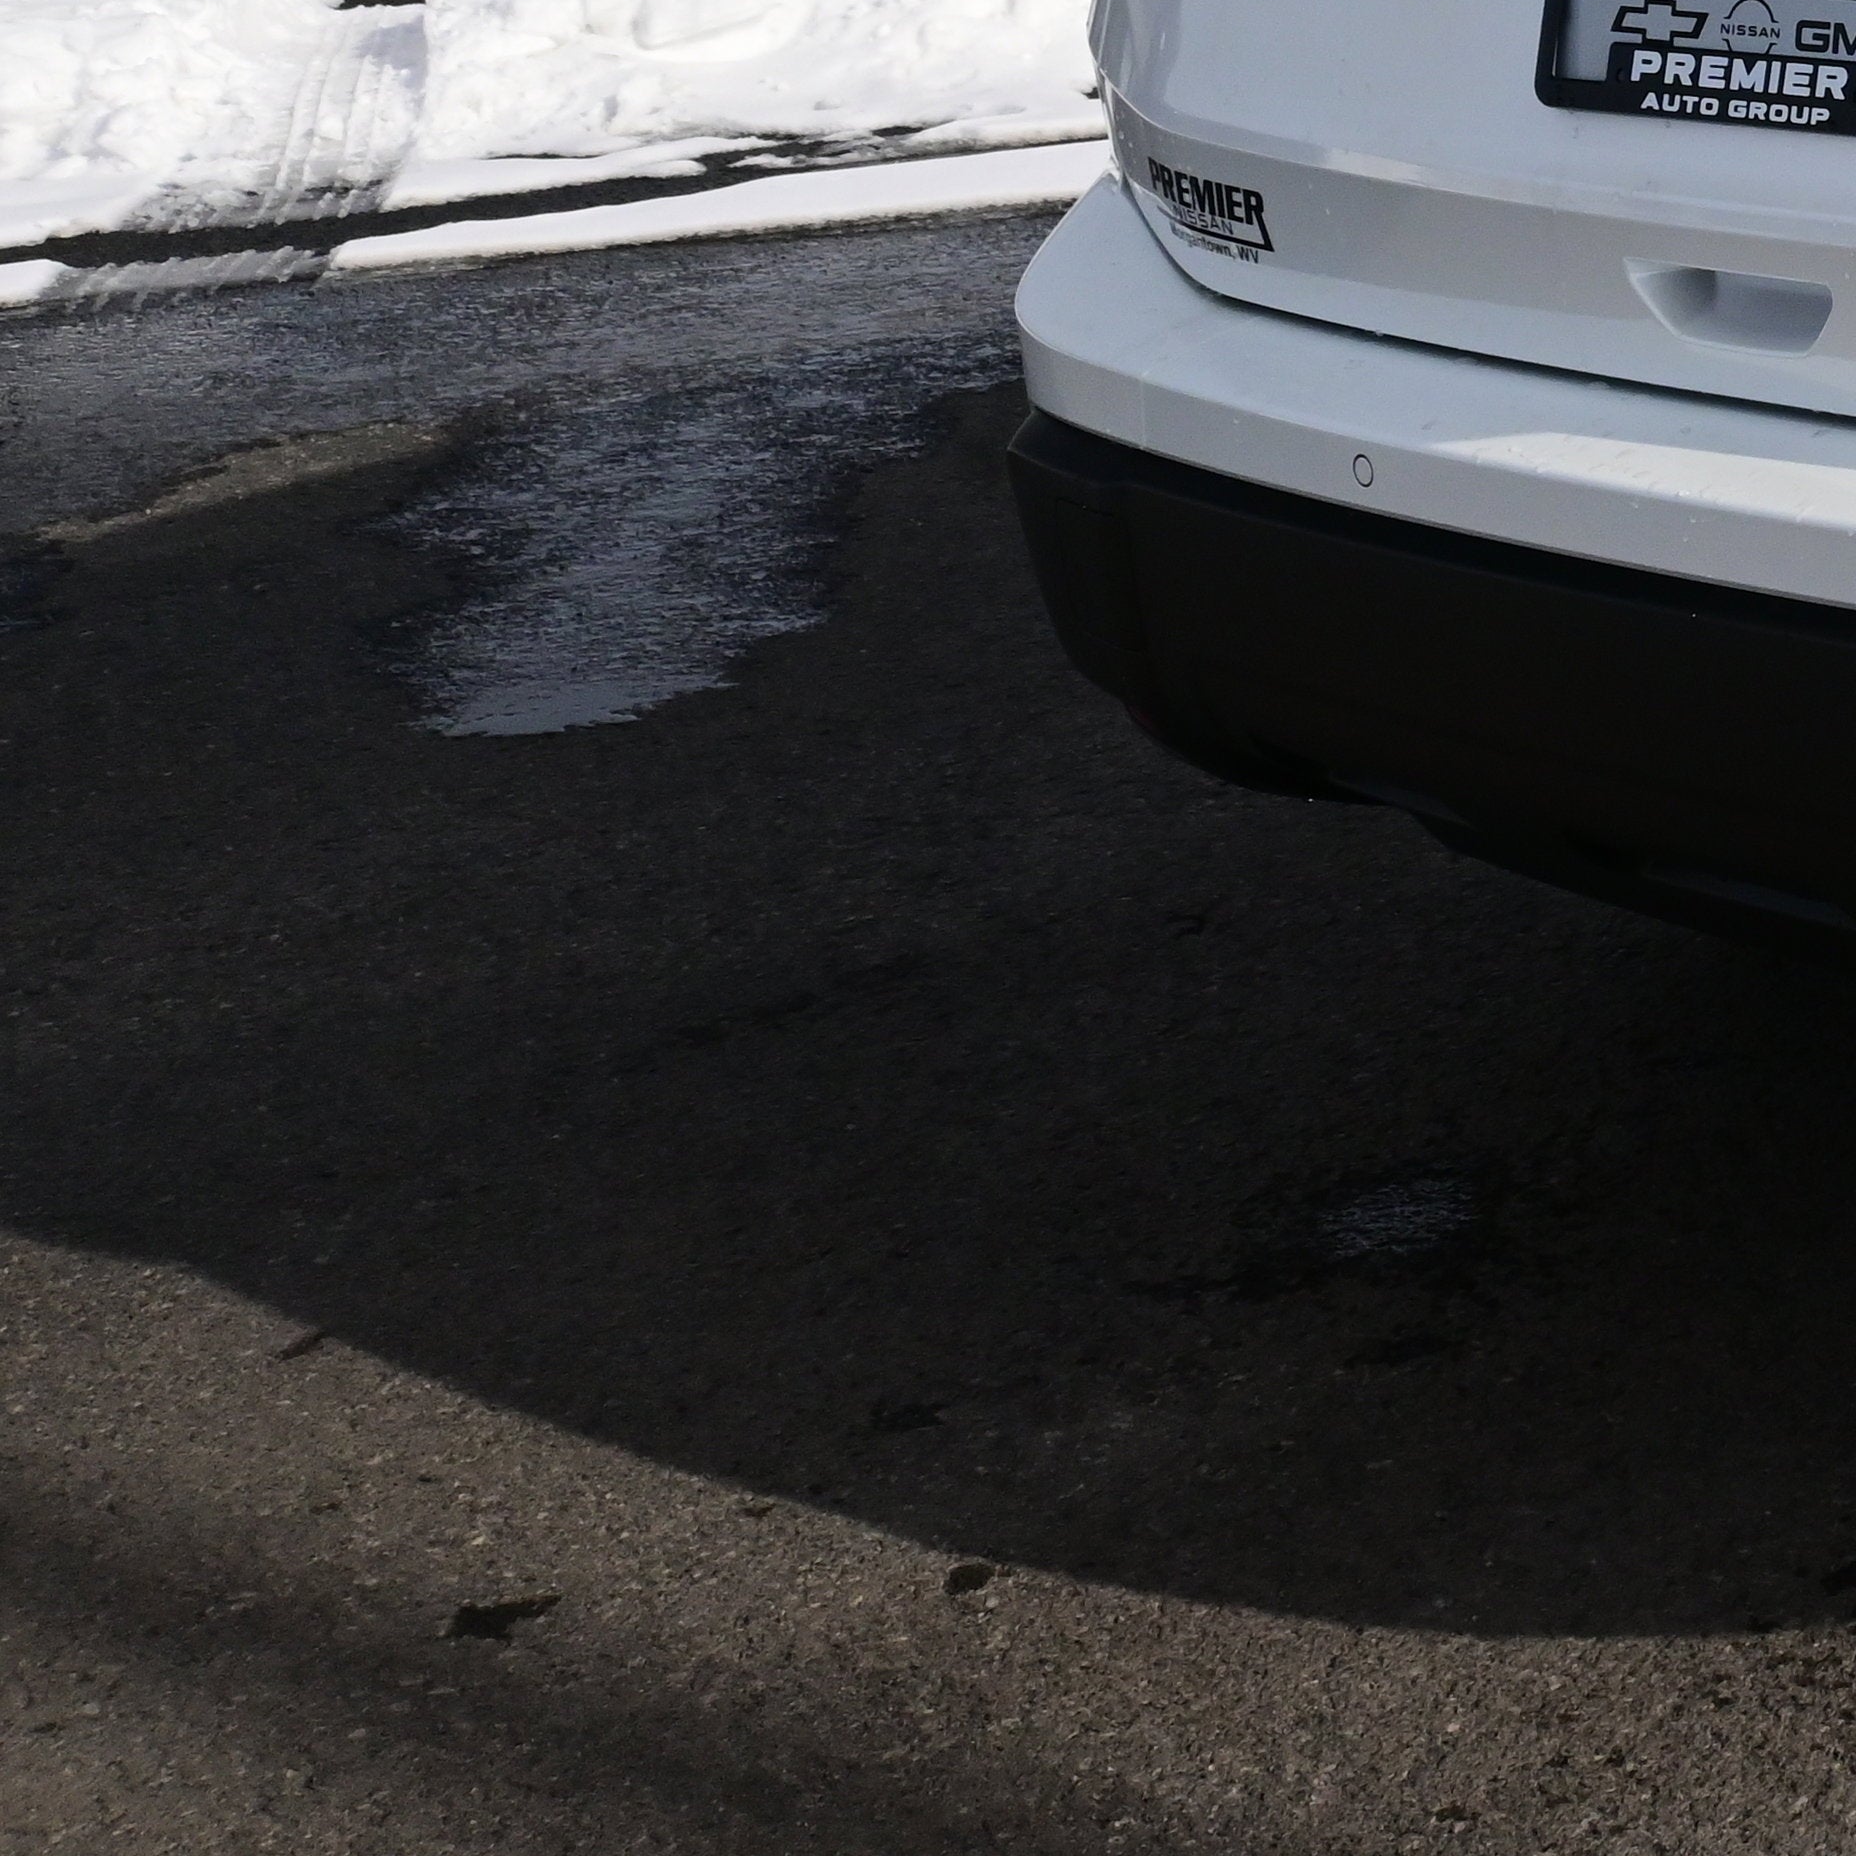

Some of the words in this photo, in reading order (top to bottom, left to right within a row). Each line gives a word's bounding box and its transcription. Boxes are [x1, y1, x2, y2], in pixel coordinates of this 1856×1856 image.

[1719, 23, 1781, 39] NISSAN
[1630, 49, 1849, 101] PREMIER
[1640, 91, 1719, 117] AUTO
[1727, 100, 1831, 126] GROUP
[1147, 156, 1268, 234] PREMIER
[1172, 204, 1235, 236] NISSAN
[1236, 245, 1260, 264] WV
